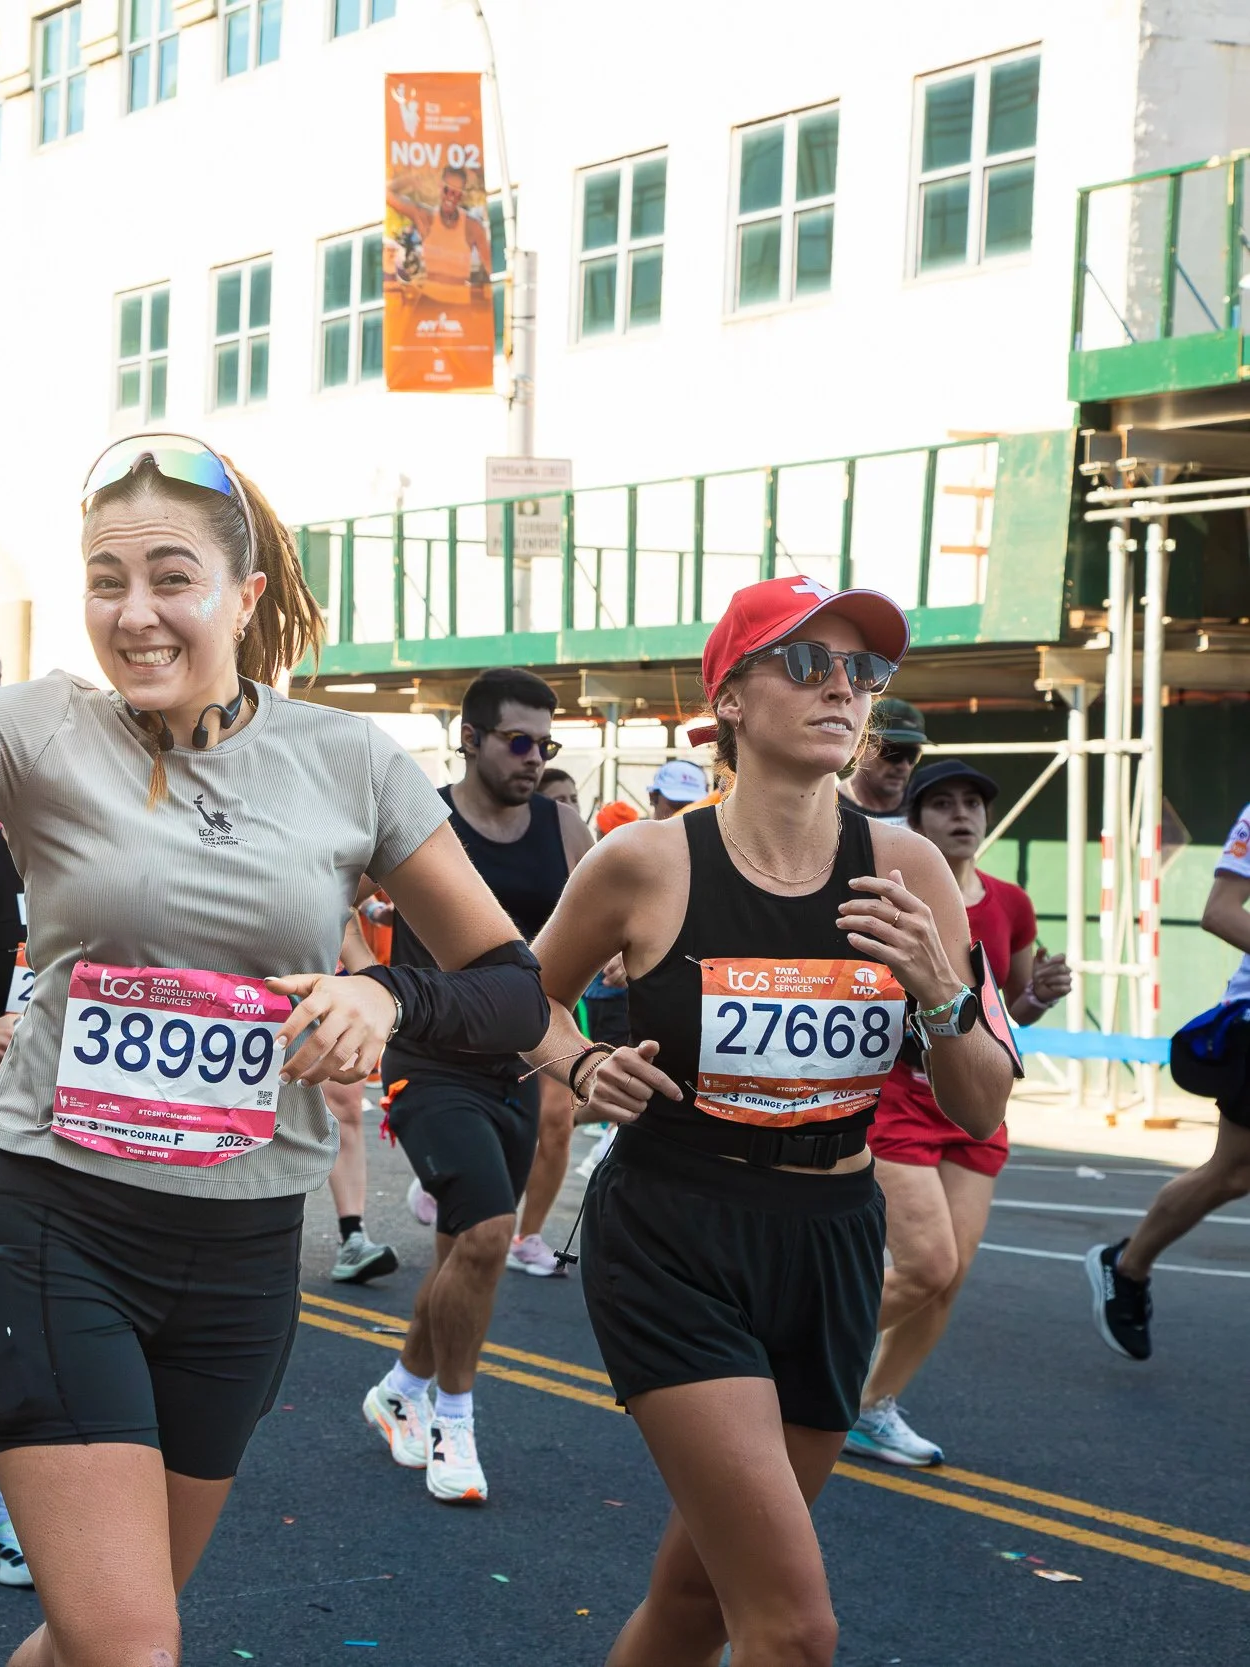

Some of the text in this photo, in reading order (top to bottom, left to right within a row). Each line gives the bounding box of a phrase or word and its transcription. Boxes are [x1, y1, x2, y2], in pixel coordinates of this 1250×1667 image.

[391, 141, 481, 169] NOV 02
[199, 829, 215, 837] tcs
[774, 967, 800, 975] TATA
[100, 968, 146, 1001] tcs
[151, 977, 181, 988] TATA
[727, 966, 770, 992] tcs
[774, 976, 835, 985] CONSULTANCY
[150, 986, 218, 1002] CONSULTANCY
[774, 984, 813, 993] SERVICES
[149, 995, 192, 1007] SERVICES
[232, 1003, 266, 1015] TATA
[715, 1001, 891, 1059] 27668
[73, 1006, 274, 1086] 38999
[728, 1092, 740, 1103] 3
[744, 1096, 782, 1110] ORANGE
[811, 1094, 820, 1105] A
[138, 1108, 202, 1122] #TCSNYCMarathon
[57, 1116, 185, 1146] WAVE 3 PINK CORRAL F
[215, 1135, 253, 1149] 2025
[125, 1145, 146, 1156] Team:
